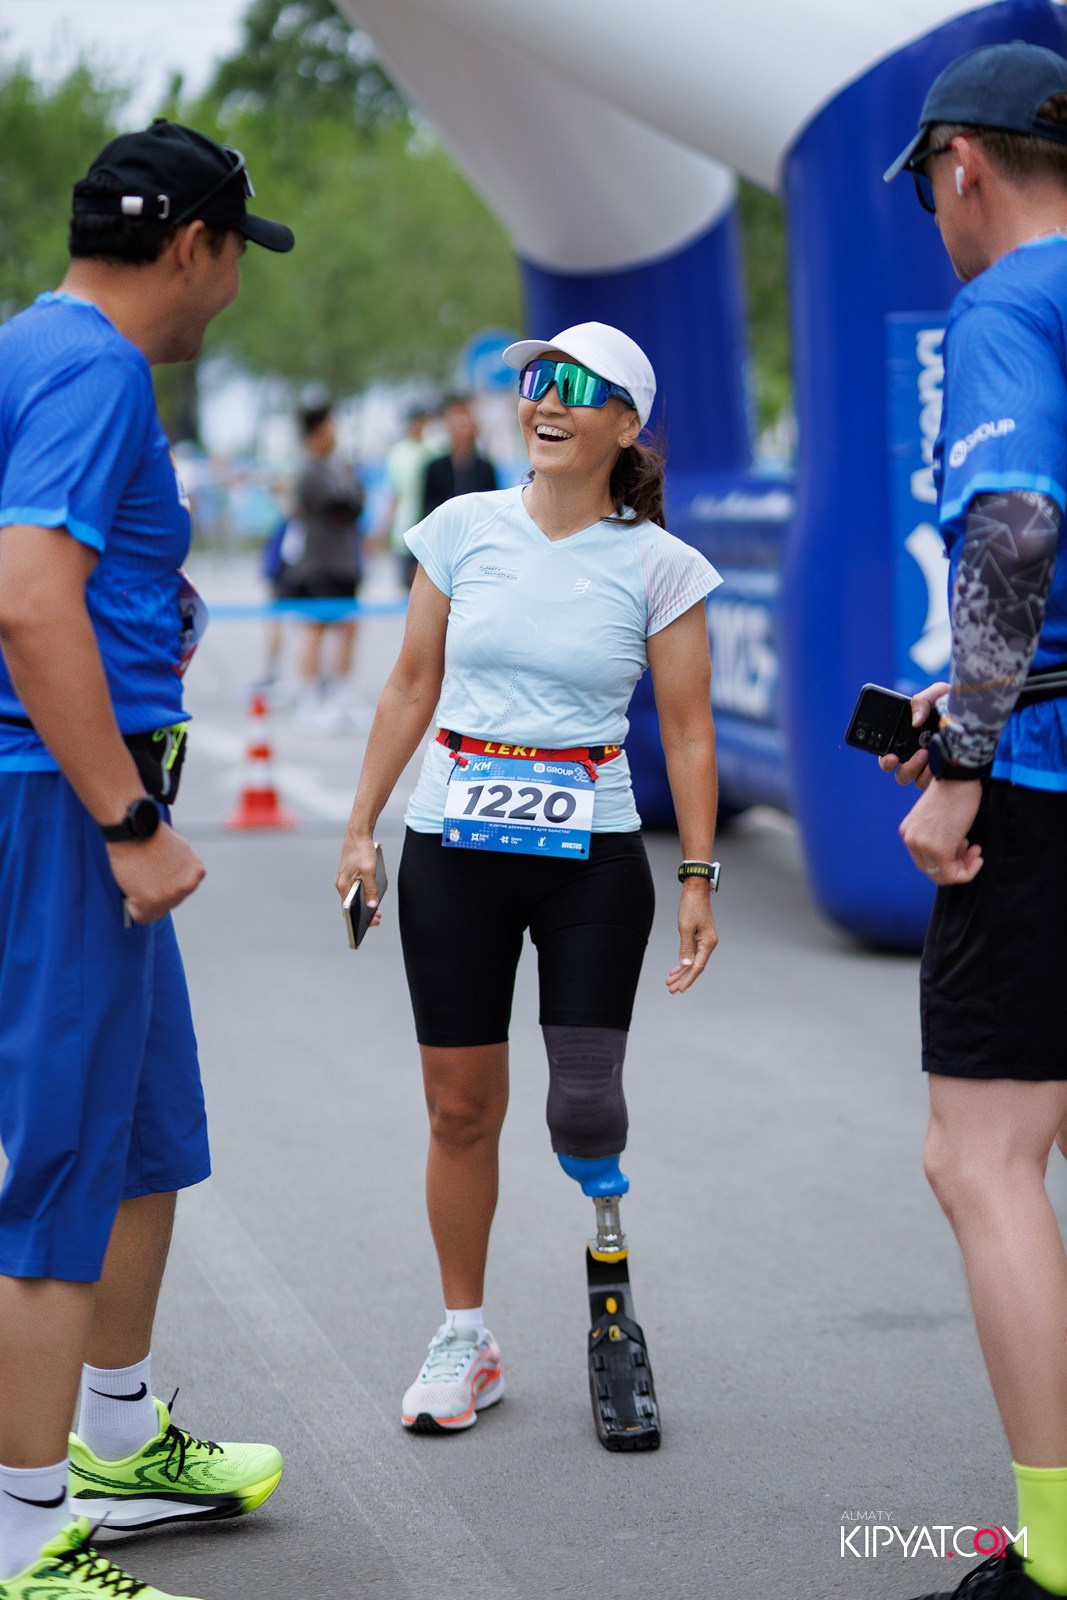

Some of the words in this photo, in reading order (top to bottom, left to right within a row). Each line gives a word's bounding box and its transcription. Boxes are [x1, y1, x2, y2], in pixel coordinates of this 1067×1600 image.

[484, 742, 537, 757] LEKI
[472, 761, 492, 771] KM
[546, 766, 574, 776] GROUP
[463, 785, 577, 824] 1220
